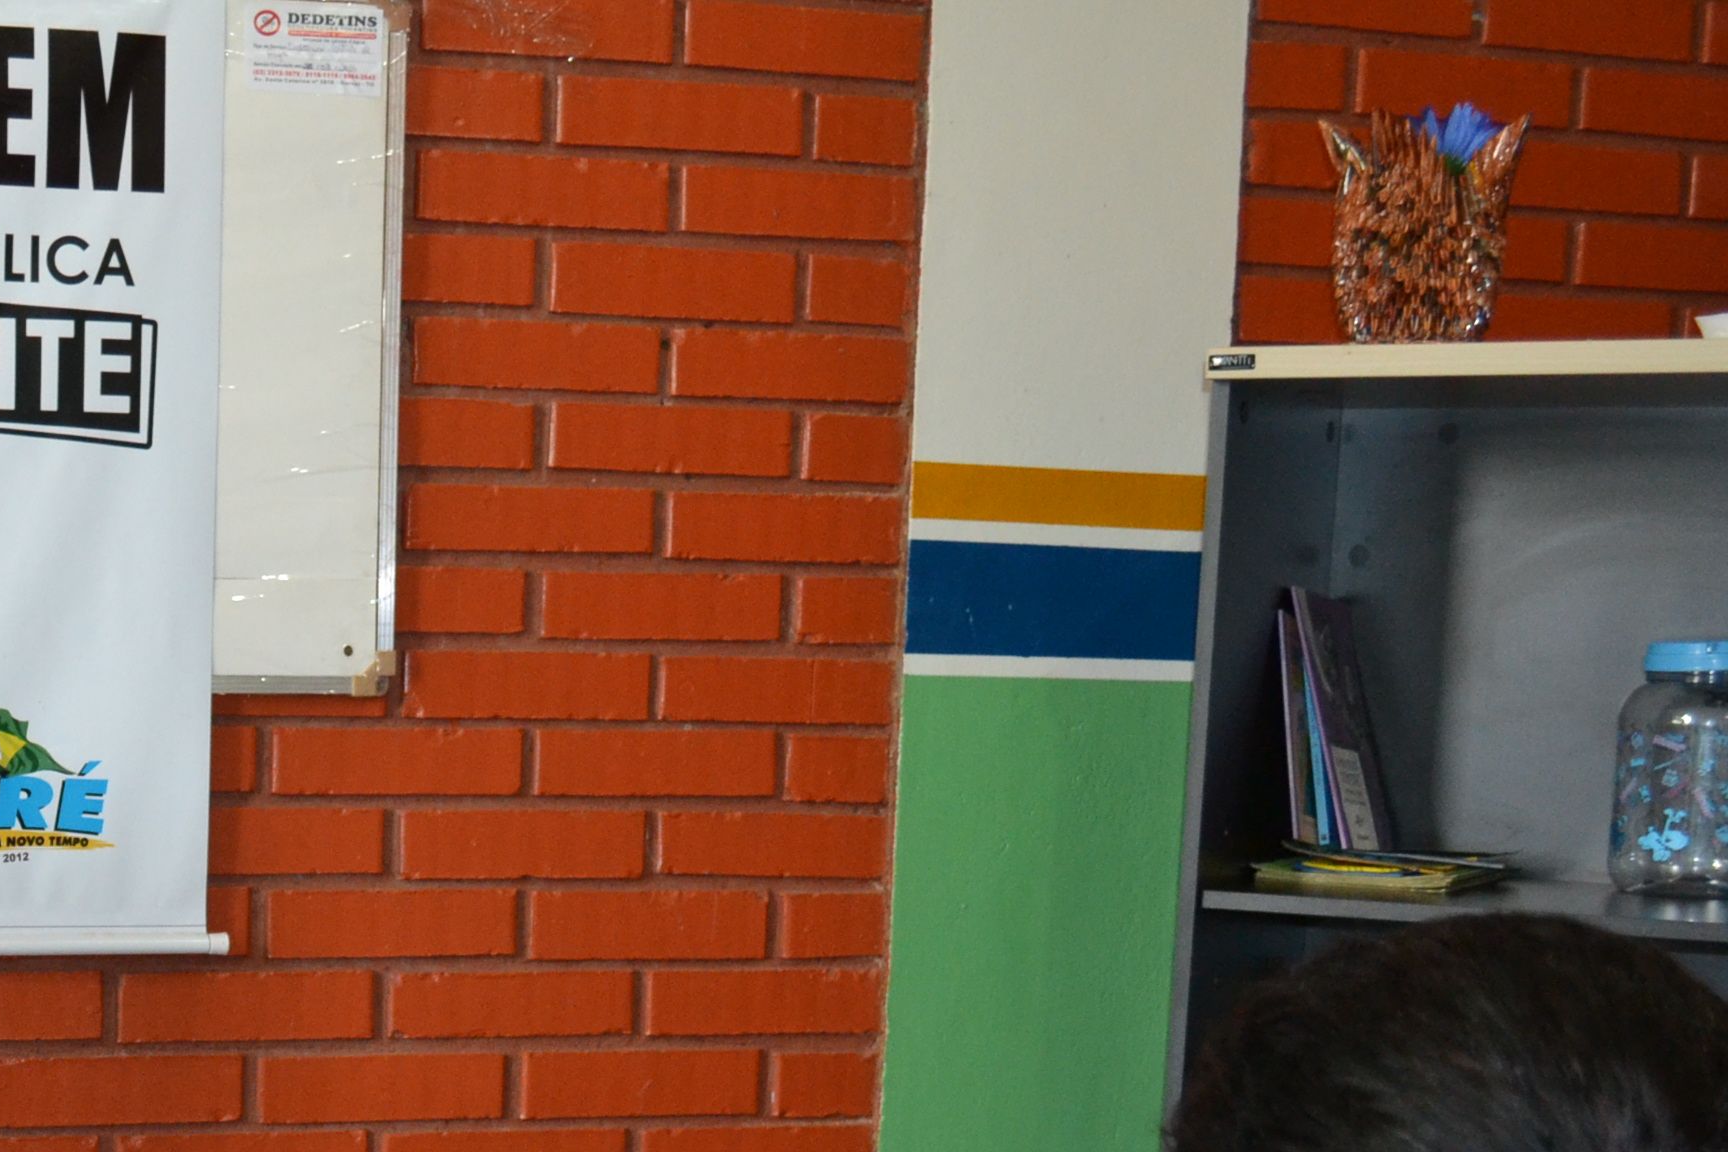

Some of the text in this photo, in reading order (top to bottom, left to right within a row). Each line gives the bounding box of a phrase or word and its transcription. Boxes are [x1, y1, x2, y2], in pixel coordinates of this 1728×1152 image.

[288, 12, 378, 28] DEDETINS
[6, 835, 45, 848] NOVO
[49, 836, 89, 848] TEMPO
[3, 852, 29, 863] 2012
